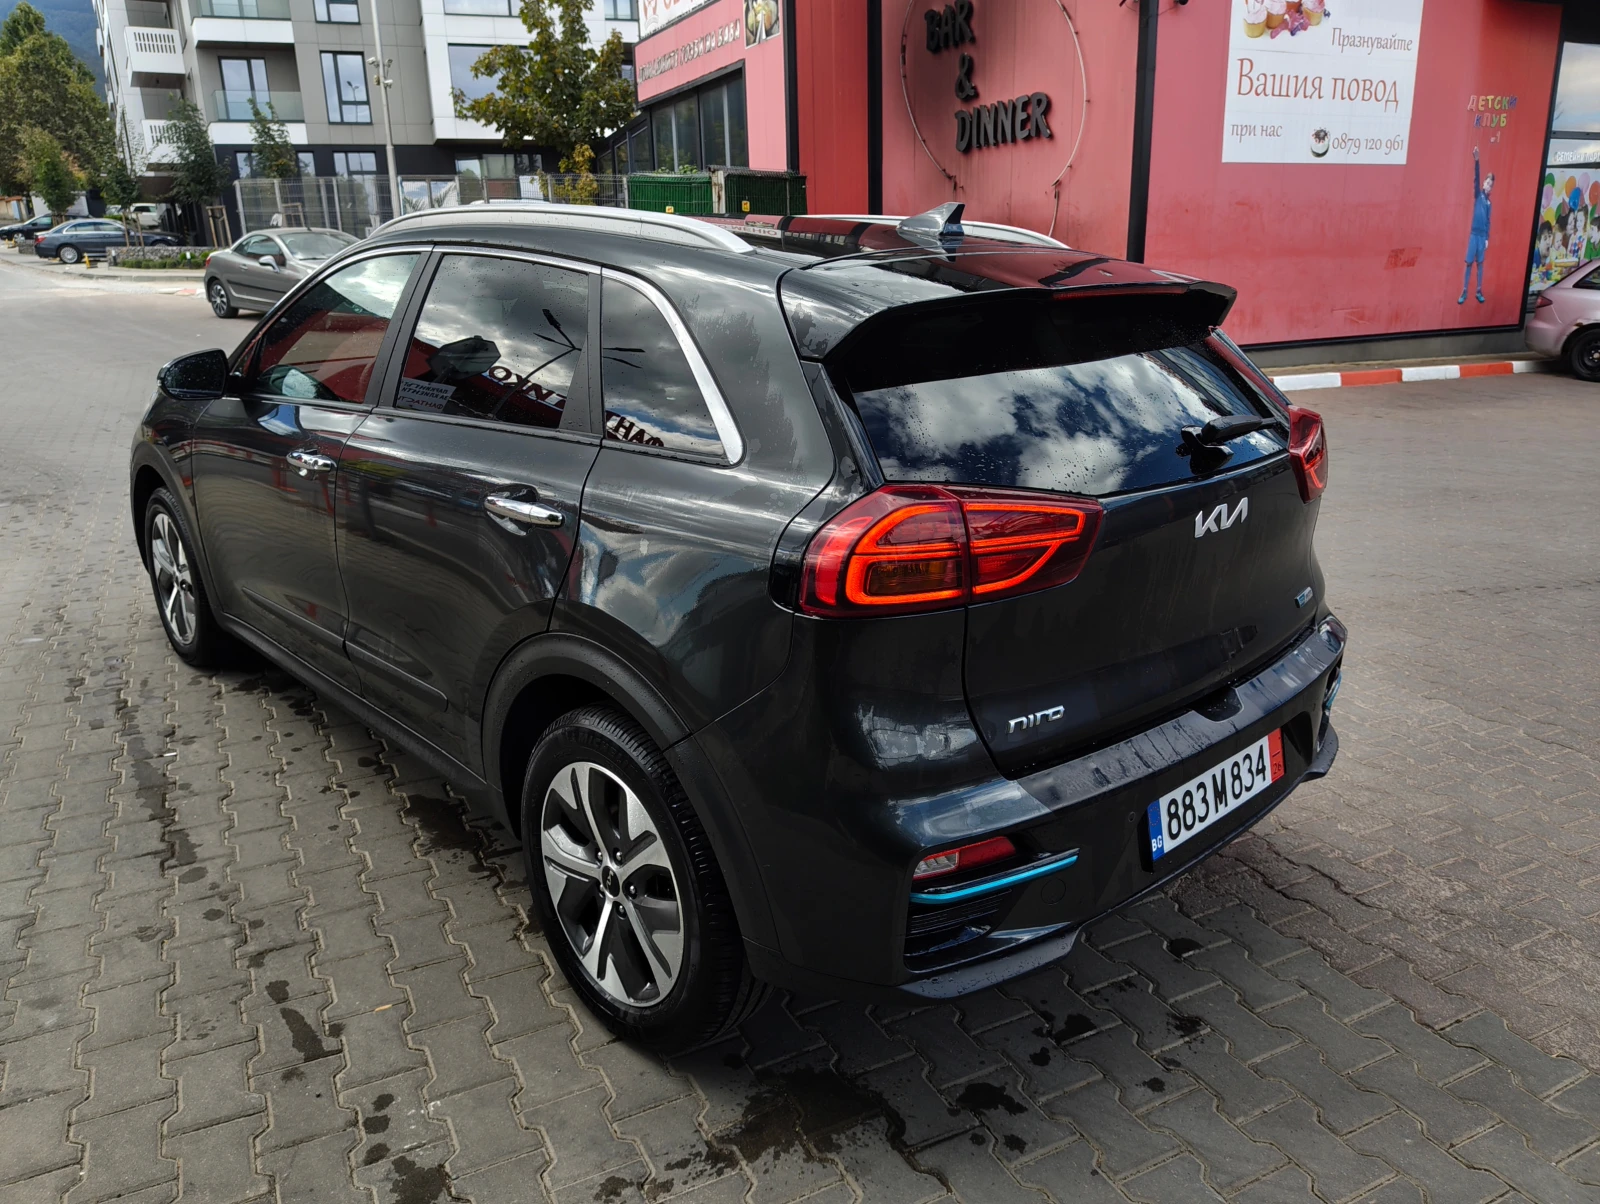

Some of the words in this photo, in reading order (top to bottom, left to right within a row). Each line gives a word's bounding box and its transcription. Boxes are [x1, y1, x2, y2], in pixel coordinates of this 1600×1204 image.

[925, 0, 975, 53] BAR
[1331, 27, 1413, 55] Празнувайте
[955, 52, 978, 102] &
[1236, 57, 1325, 100] Вашия
[1331, 77, 1400, 114] повод
[1467, 94, 1518, 111] ДЕТСКИ
[954, 91, 1053, 153] DINNER
[1230, 123, 1257, 143] при
[1260, 124, 1283, 138] нас
[1474, 112, 1507, 128] КЛУБ
[1331, 132, 1361, 155] 0879
[1365, 137, 1382, 151] 120
[1385, 134, 1404, 156] 961
[1194, 496, 1249, 539] KIA
[1151, 835, 1163, 852] BG
